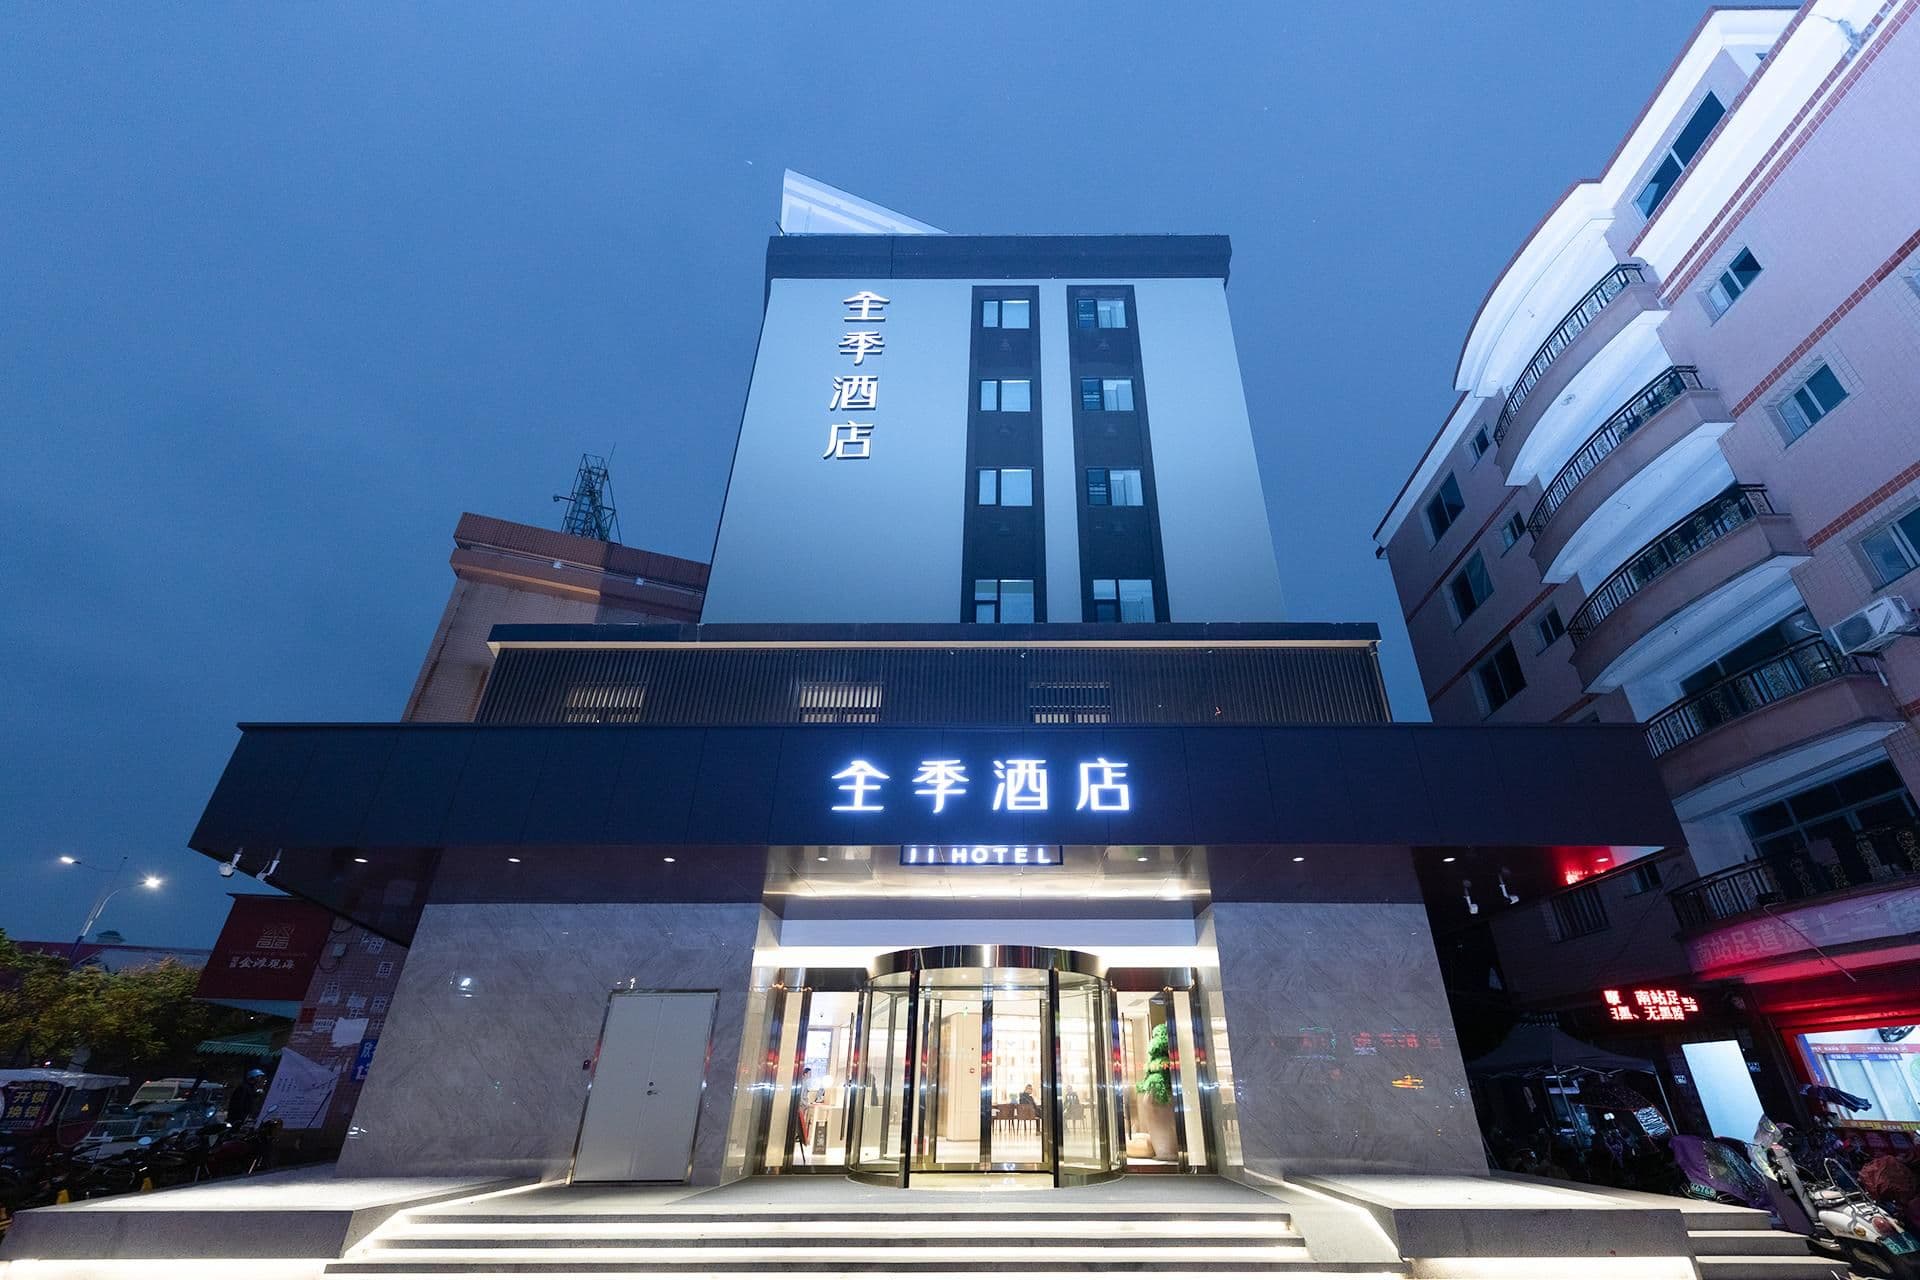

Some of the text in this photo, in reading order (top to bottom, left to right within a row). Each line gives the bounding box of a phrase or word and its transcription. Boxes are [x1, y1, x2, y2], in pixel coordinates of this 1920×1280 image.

[823, 291, 890, 459] 全季酒店
[831, 758, 1131, 813] 全季酒店
[951, 847, 1052, 864] HOTEL
